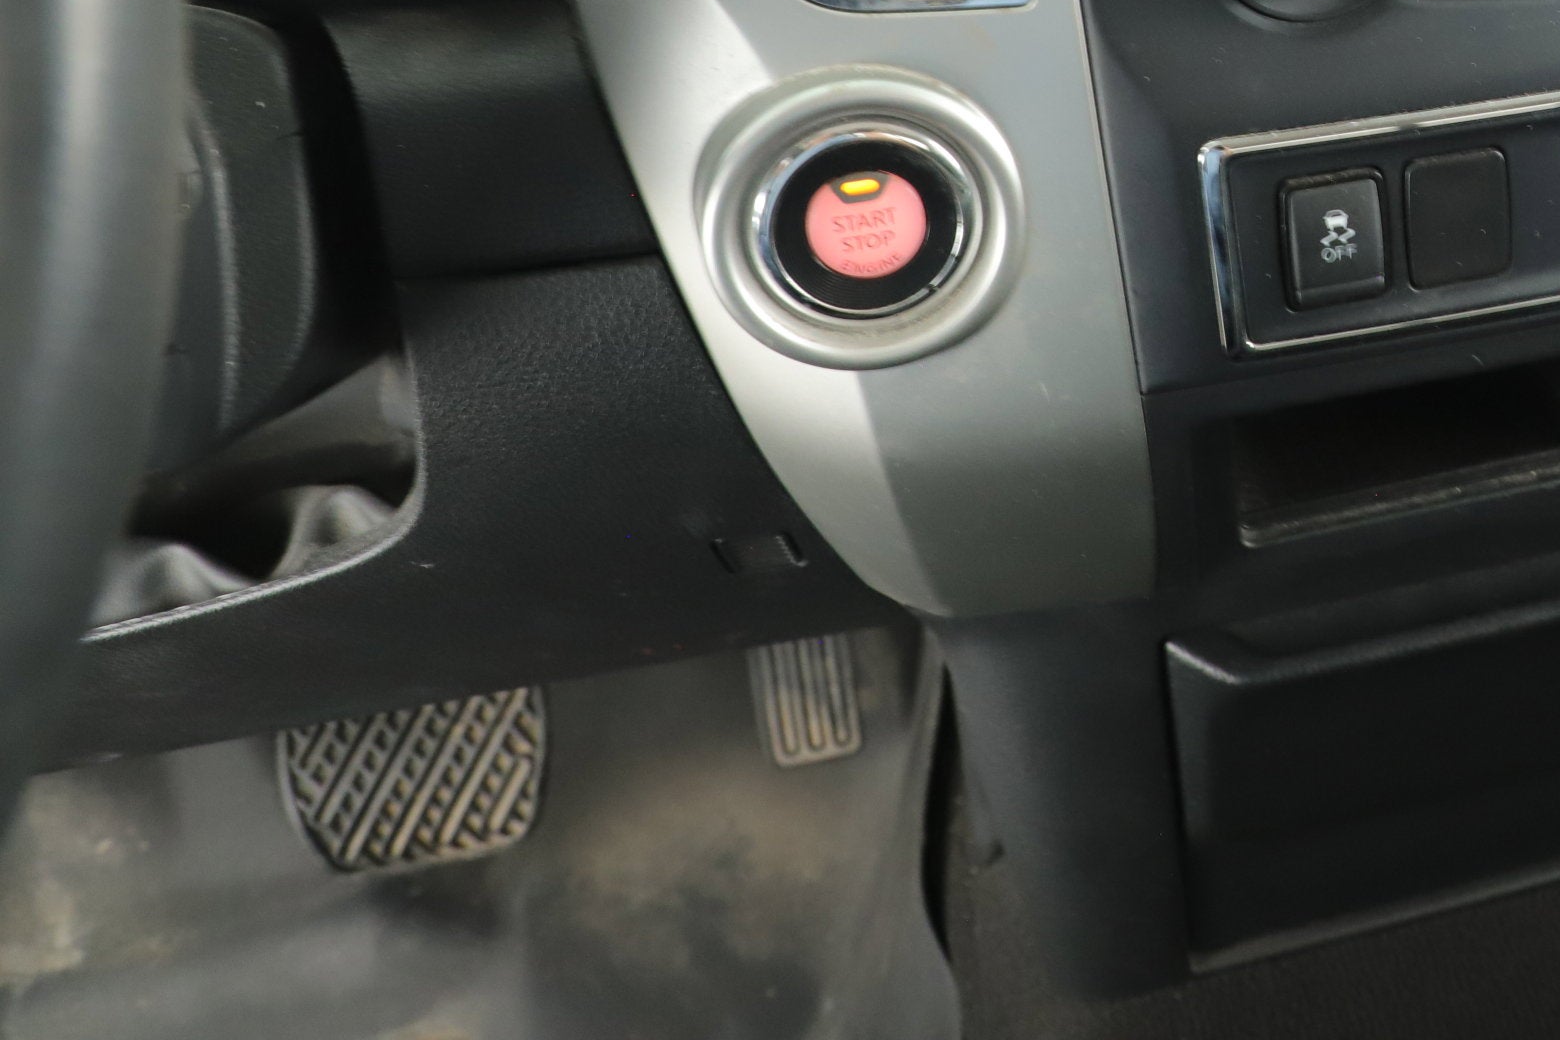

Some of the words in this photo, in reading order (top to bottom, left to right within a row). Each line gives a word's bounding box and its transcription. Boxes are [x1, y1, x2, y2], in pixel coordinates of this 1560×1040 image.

[831, 206, 896, 233] START
[841, 230, 896, 252] STOP
[841, 252, 902, 274] ENGINE
[1321, 243, 1358, 263] OFF
